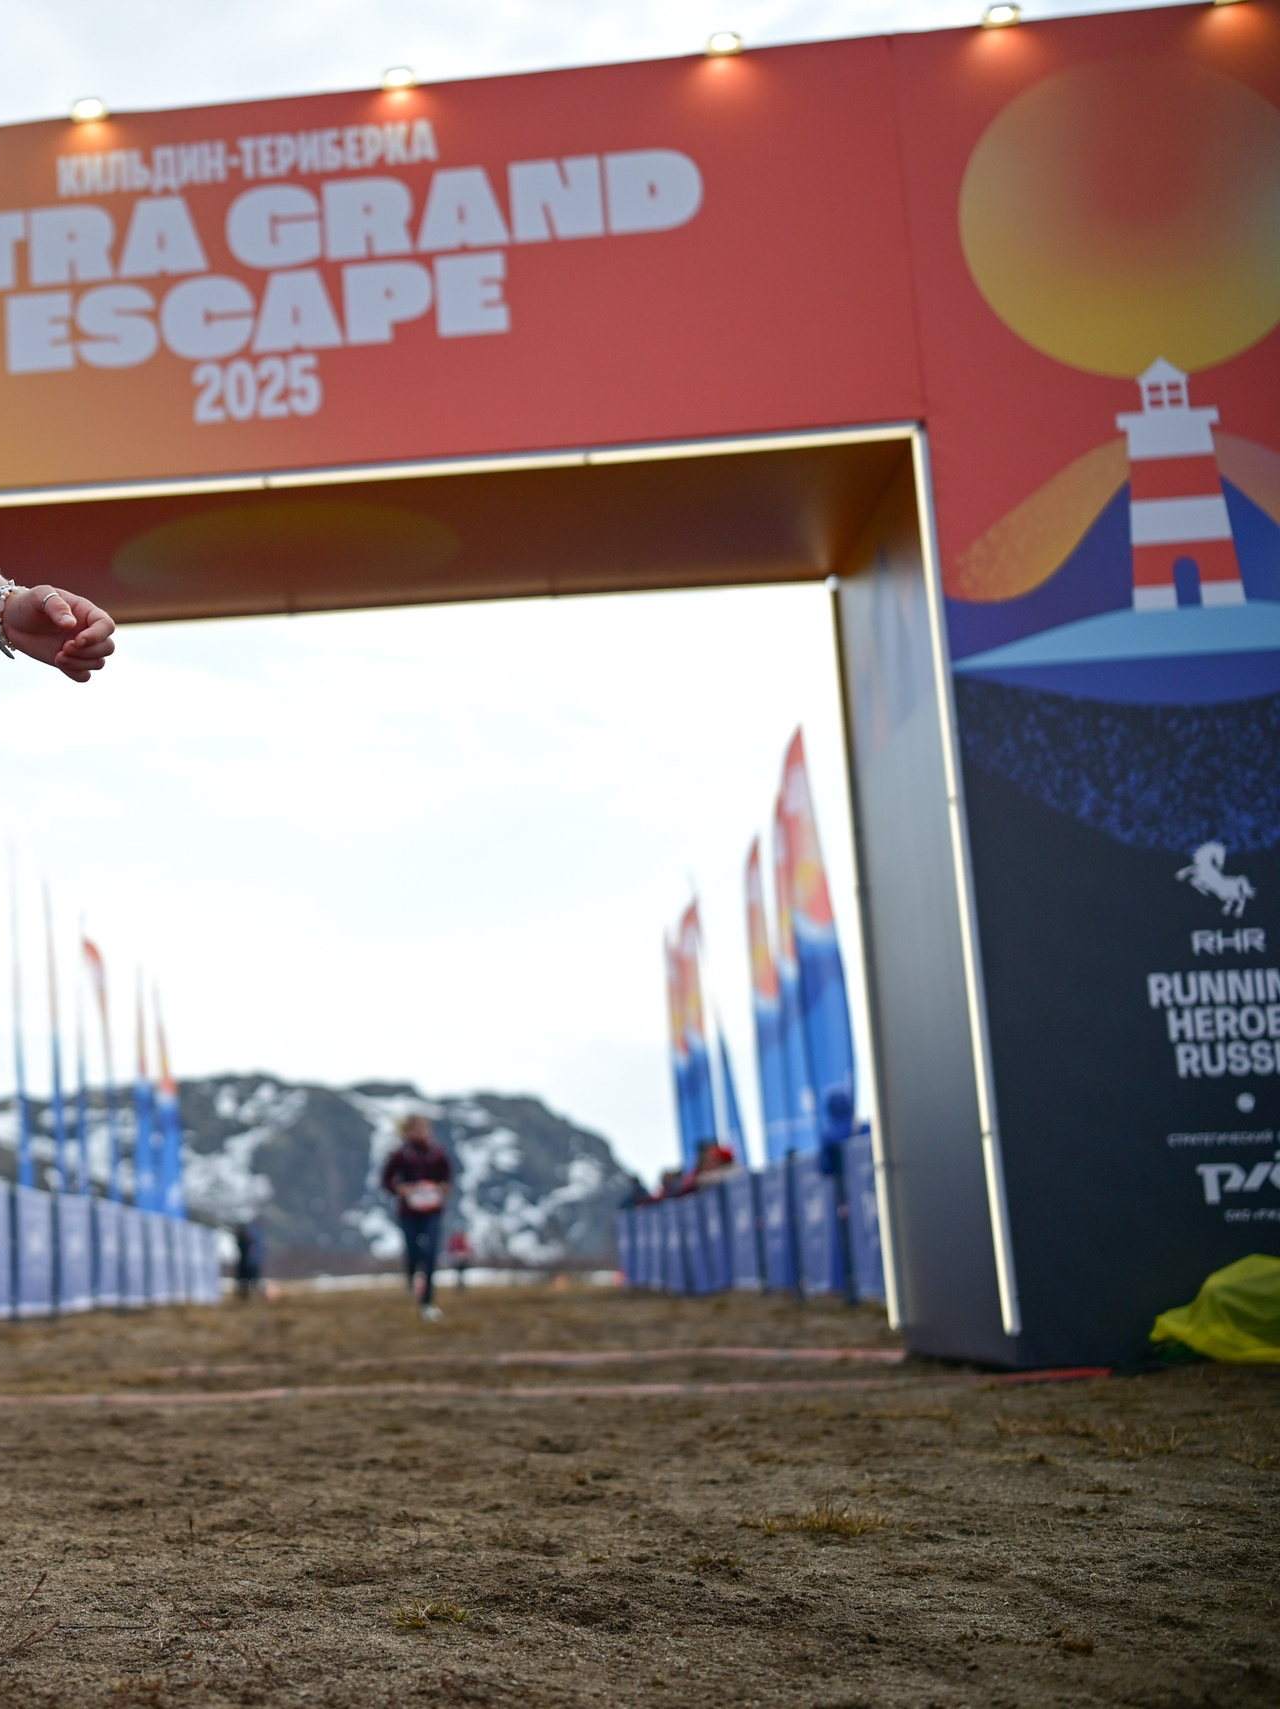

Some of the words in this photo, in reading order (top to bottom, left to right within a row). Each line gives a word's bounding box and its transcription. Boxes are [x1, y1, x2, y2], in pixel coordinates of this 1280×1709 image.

[56, 118, 438, 198] КИЛЬДИН-ТЕРИБЕРКА
[224, 148, 704, 270] GRAND
[4, 252, 511, 374] ESCAPE
[191, 354, 323, 424] 2025
[1190, 927, 1266, 956] RHR
